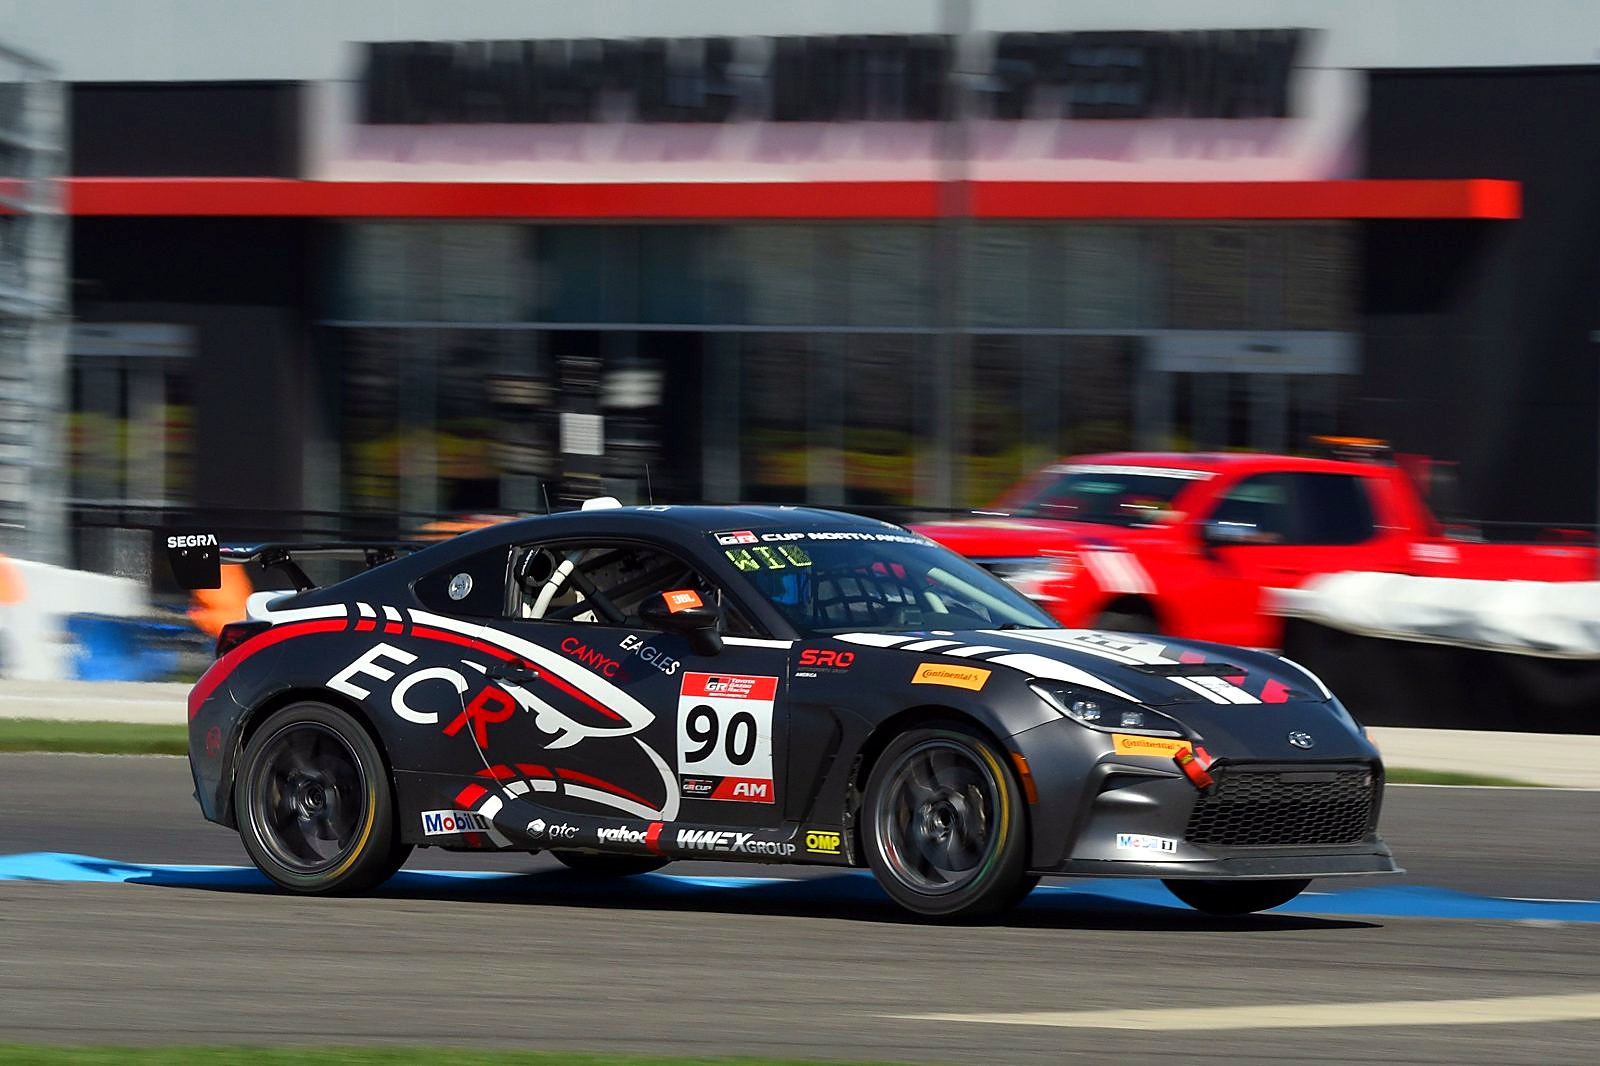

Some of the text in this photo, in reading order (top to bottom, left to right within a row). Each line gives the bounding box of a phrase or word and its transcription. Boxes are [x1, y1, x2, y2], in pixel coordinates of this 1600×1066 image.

[167, 534, 218, 548] SEGRA
[719, 534, 757, 545] GR
[761, 533, 805, 541] CUP
[807, 532, 876, 541] NORTH
[671, 593, 695, 605] JBL
[619, 634, 681, 675] EAGLES
[799, 649, 855, 667] SRO
[922, 669, 972, 681] Continental
[705, 681, 728, 693] GR
[326, 642, 516, 749] ECR
[684, 703, 758, 766] 90
[733, 782, 767, 797] AM
[425, 812, 474, 832] Mobil
[548, 823, 576, 839] ptc
[806, 834, 841, 850] OMP
